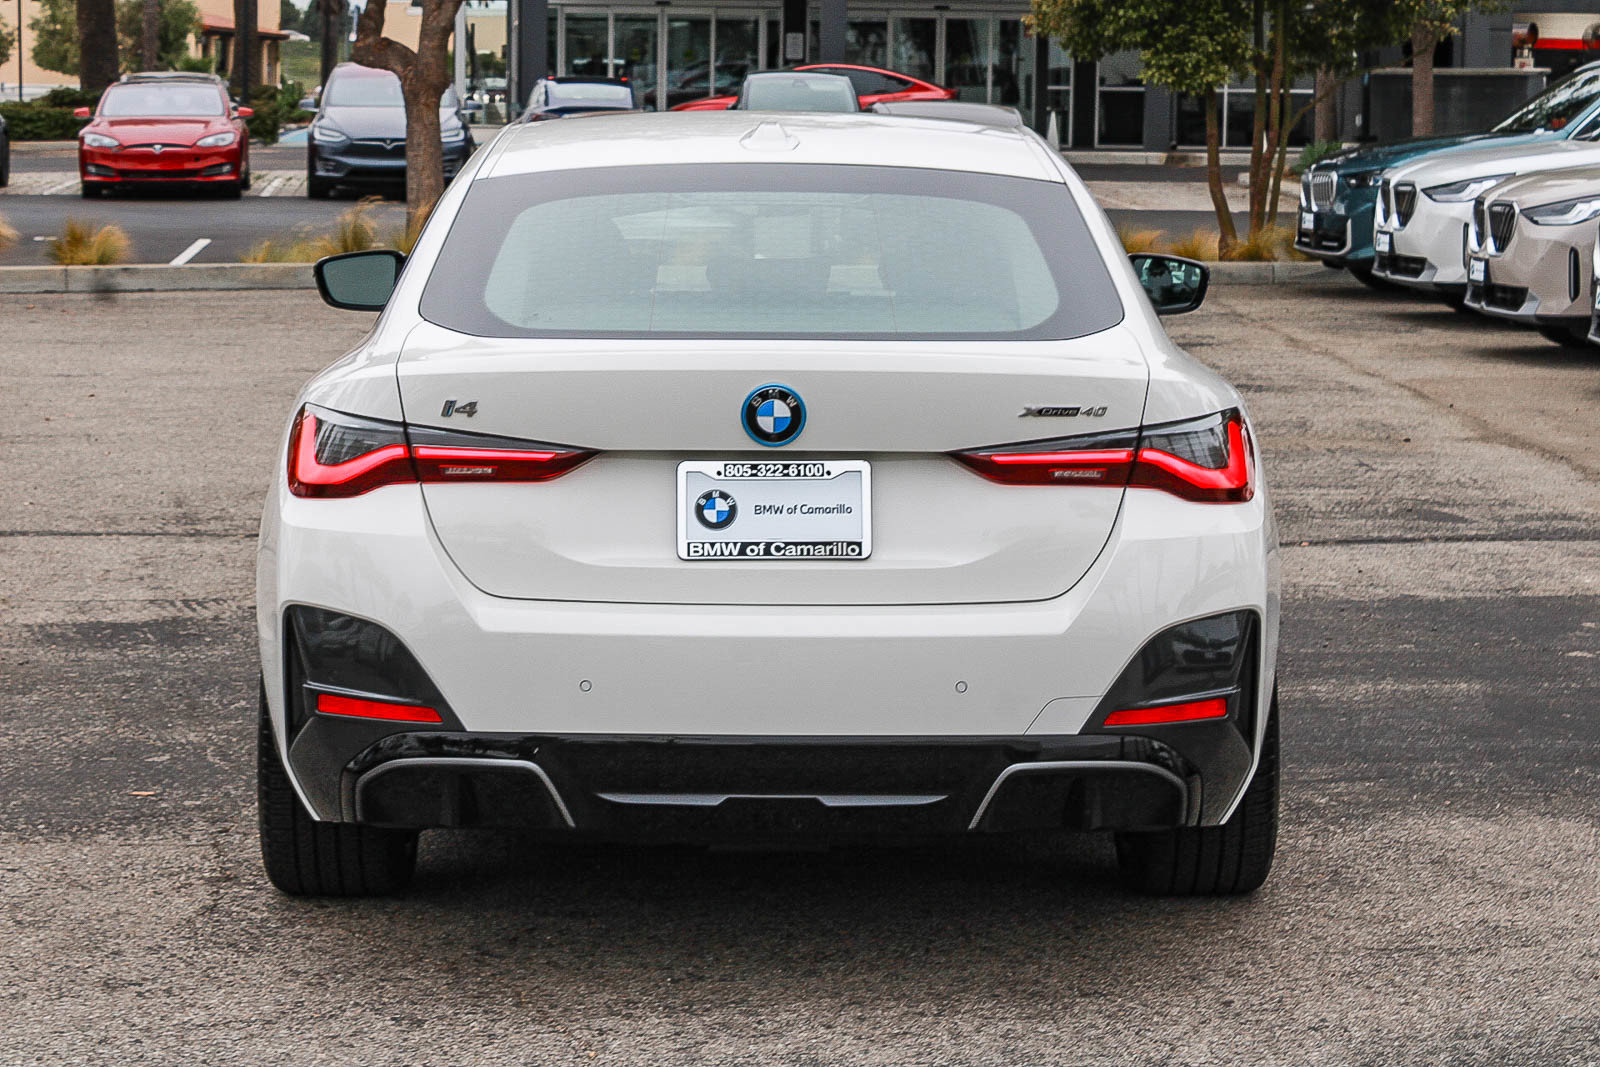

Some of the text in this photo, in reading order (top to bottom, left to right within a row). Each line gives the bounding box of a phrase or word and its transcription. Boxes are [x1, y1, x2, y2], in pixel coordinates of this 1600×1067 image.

[751, 388, 798, 408] BMW
[724, 464, 824, 477] 805-322-6100
[697, 490, 736, 506] BMW
[754, 503, 853, 515] BMW of Camarillo
[689, 542, 860, 556] BMW of Camarillo
